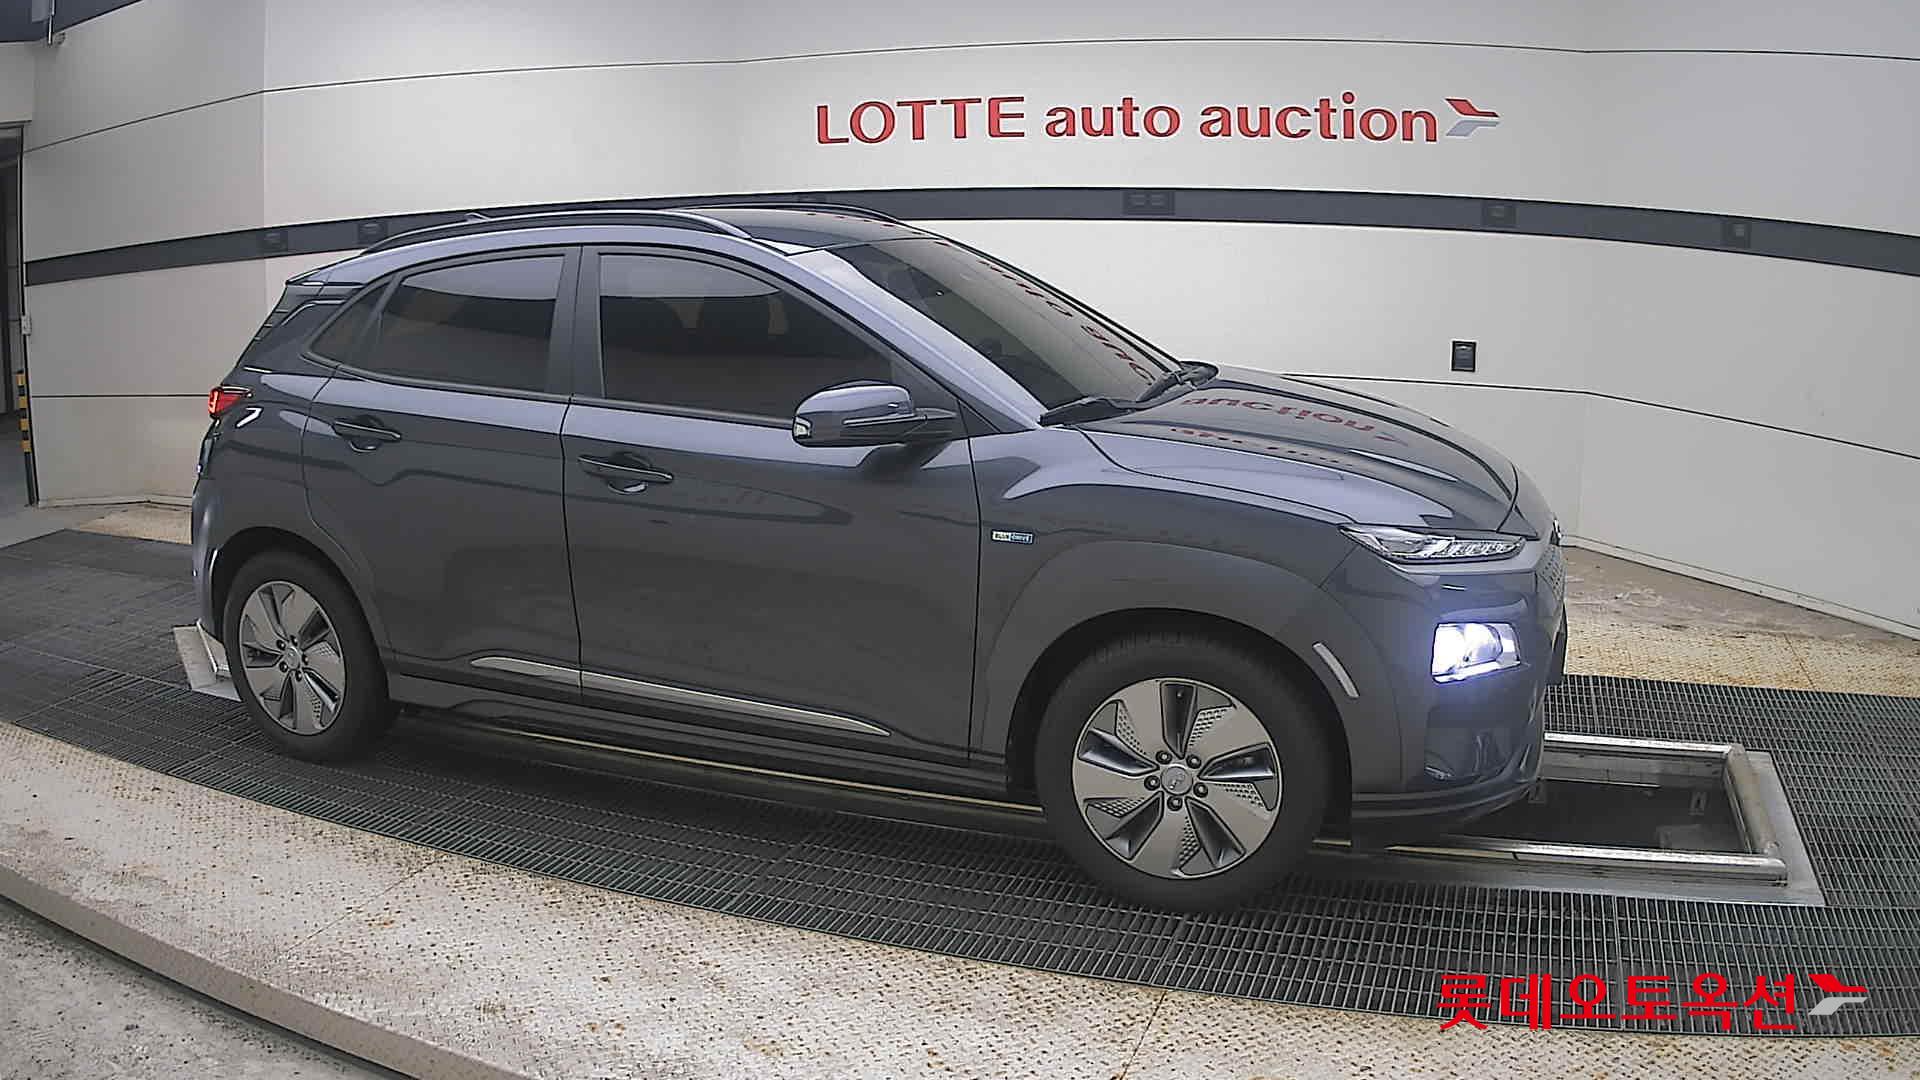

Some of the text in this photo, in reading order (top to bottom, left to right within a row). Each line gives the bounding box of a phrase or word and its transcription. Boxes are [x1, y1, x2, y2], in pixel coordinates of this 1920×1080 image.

[816, 91, 1440, 144] LOTTE auto auction
